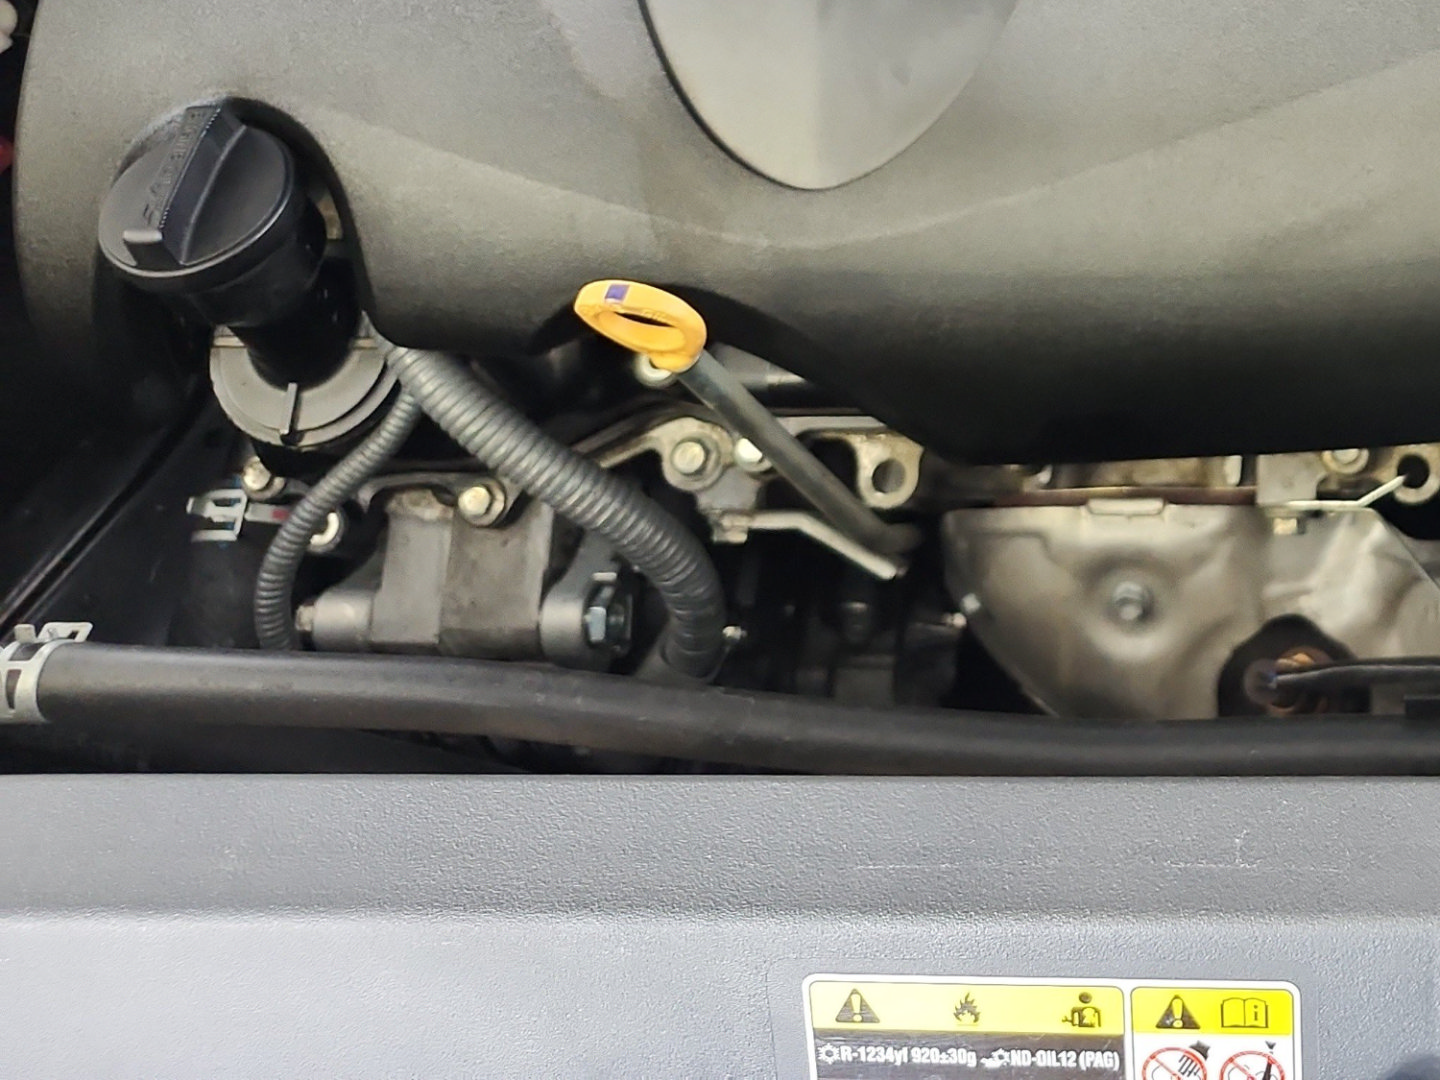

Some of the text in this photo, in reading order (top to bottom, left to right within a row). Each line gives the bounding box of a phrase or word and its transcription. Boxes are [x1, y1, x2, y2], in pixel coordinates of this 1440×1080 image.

[840, 1045, 909, 1066] R-1234yf
[910, 1046, 978, 1068] 920±30g
[1078, 1050, 1120, 1071] (PAG)
